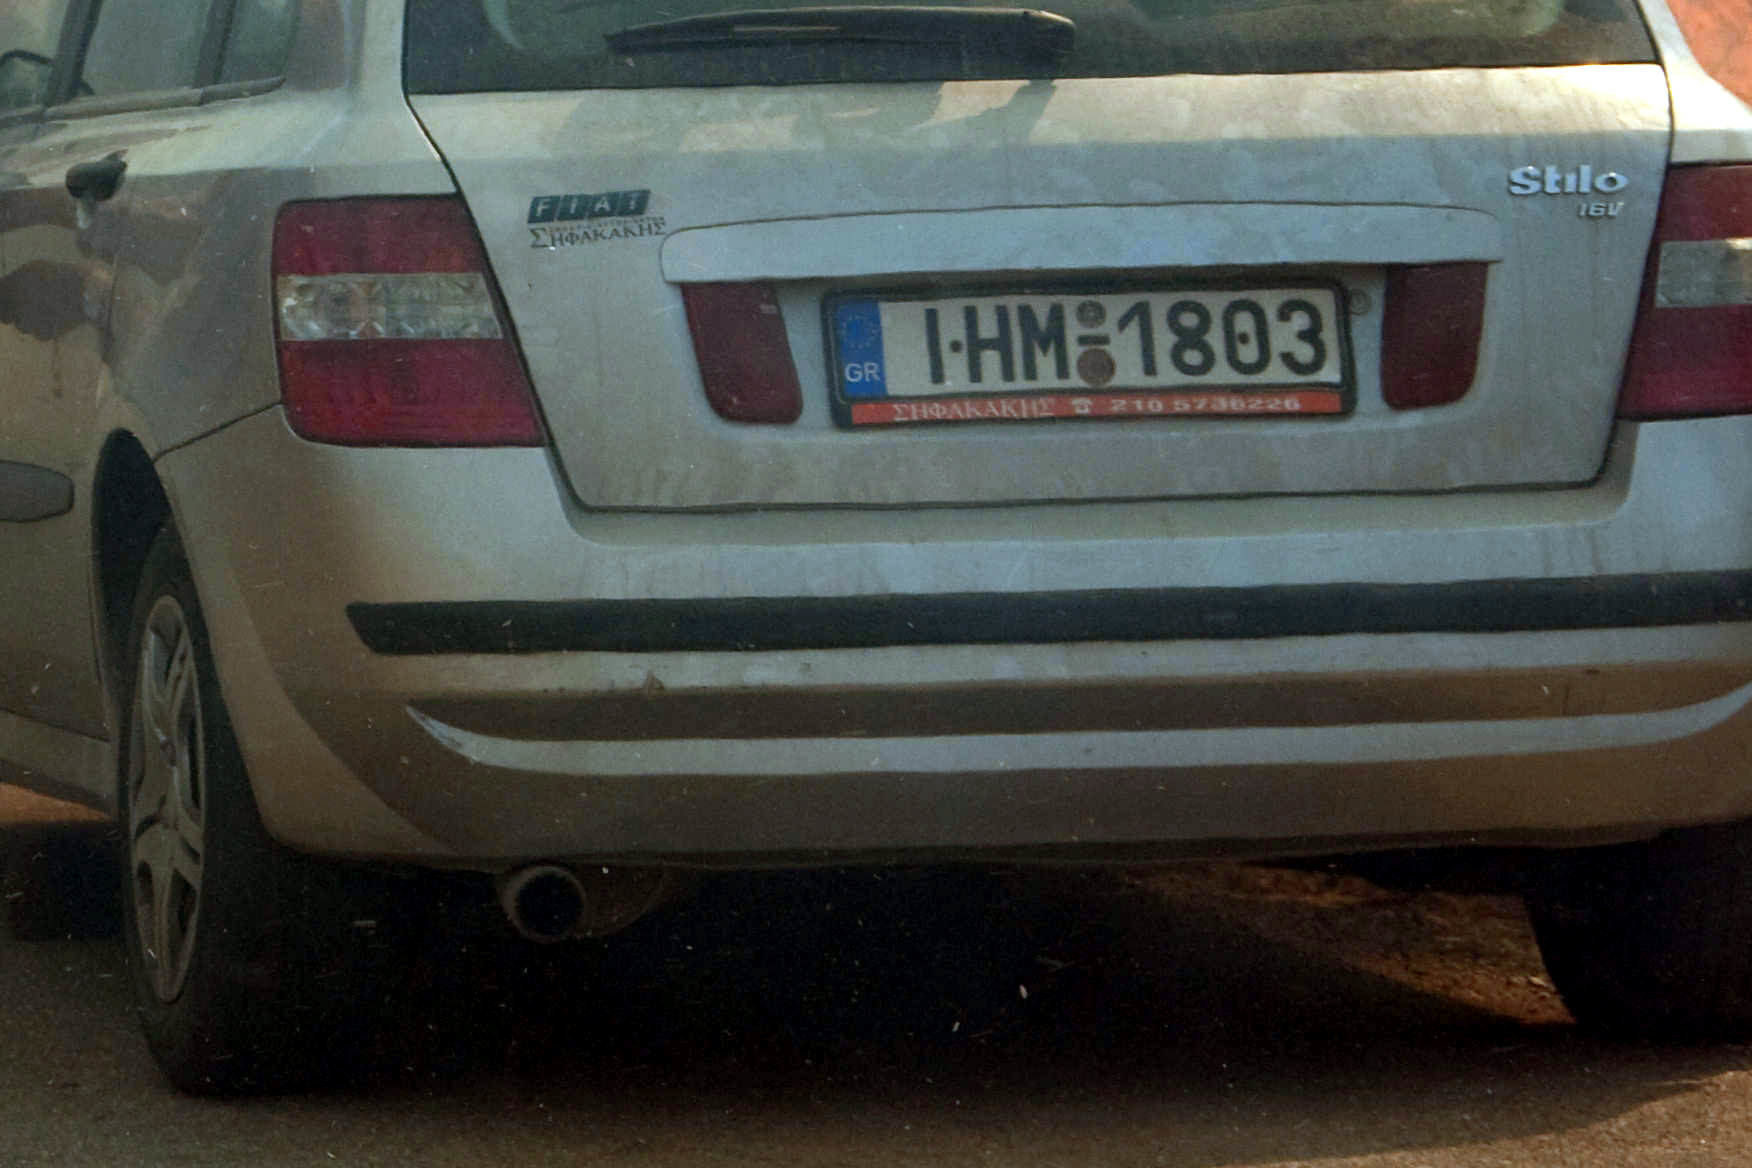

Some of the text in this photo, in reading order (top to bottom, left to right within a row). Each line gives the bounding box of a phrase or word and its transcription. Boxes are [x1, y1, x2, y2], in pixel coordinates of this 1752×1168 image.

[1508, 164, 1629, 195] Stilo
[532, 192, 645, 220] FIAT
[843, 362, 881, 383] GR
[1111, 399, 1164, 413] 210
